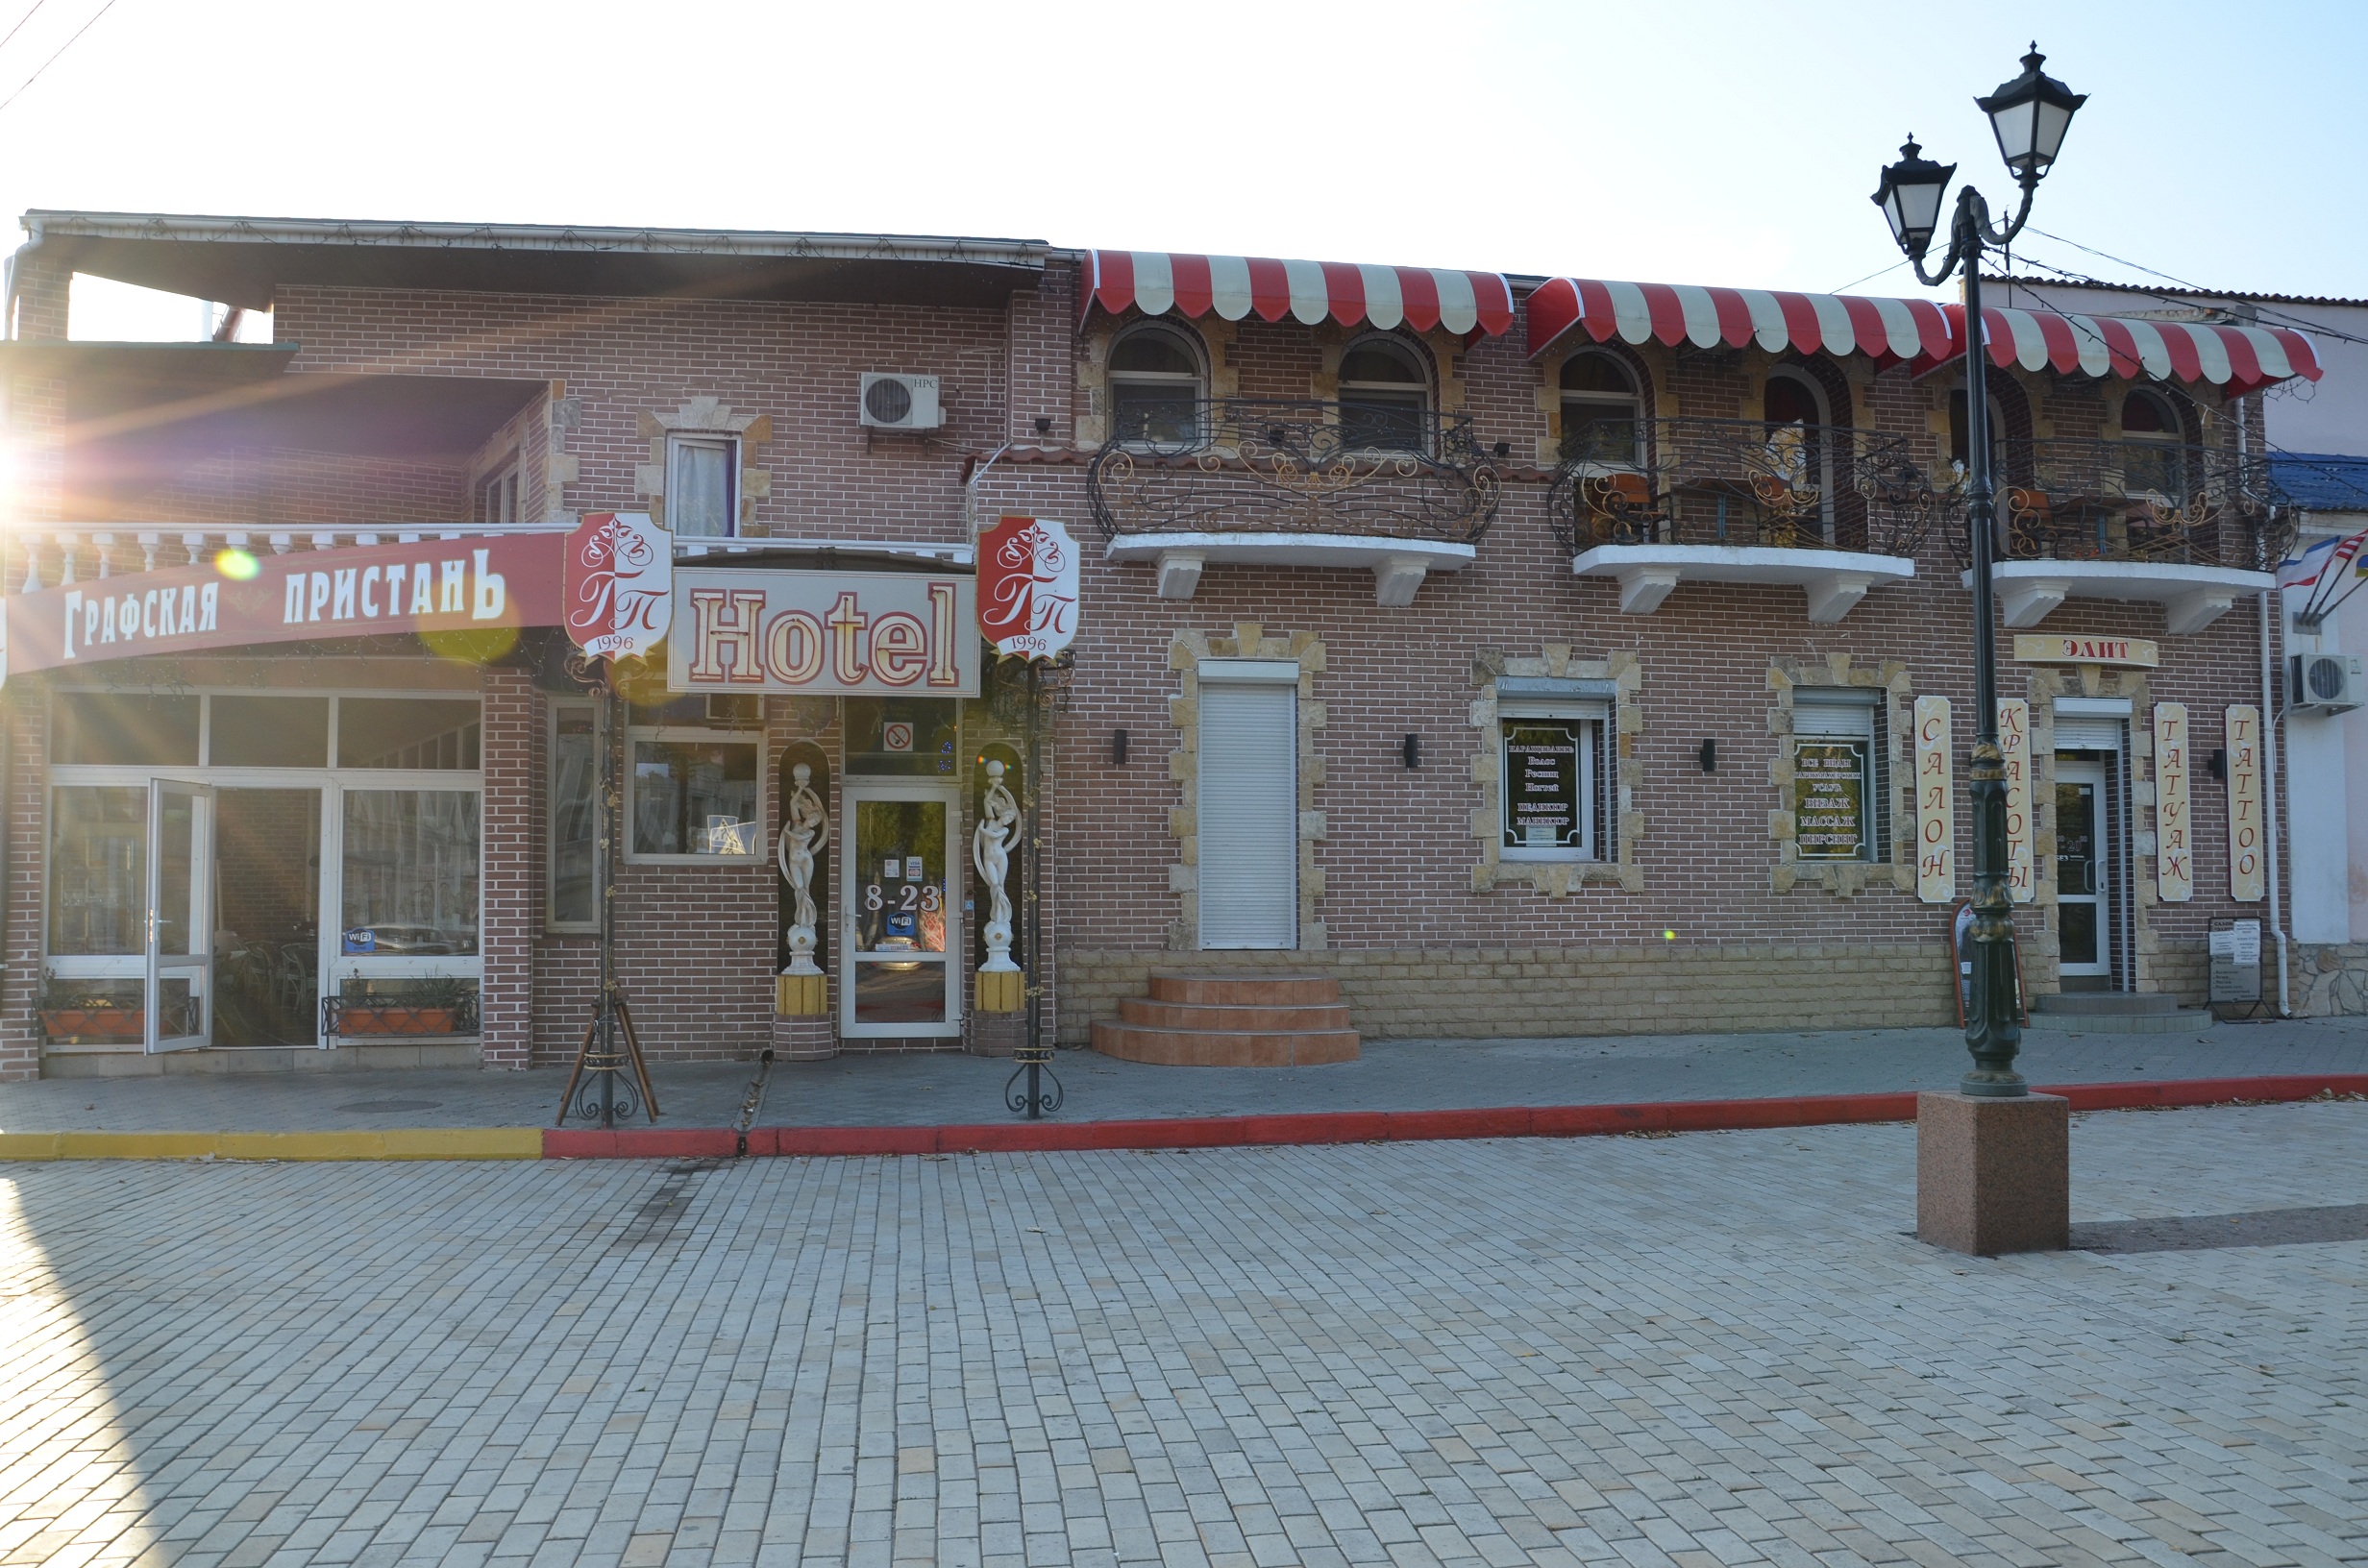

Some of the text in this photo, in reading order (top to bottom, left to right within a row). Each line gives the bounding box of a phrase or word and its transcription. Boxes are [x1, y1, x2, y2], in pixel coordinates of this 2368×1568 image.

[914, 379, 938, 389] HPC
[63, 548, 506, 660] ГРАФСКАЯ ПРИСТАНЬ
[689, 581, 960, 688] Hotel
[597, 635, 634, 651] 1996
[1011, 635, 1047, 651] 1996
[2061, 638, 2130, 659] ЭЛИТ
[1805, 797, 1850, 809] ВИЗАЖ
[1922, 718, 1950, 878] САЛОН
[1999, 707, 2029, 888] КРАСОТЫ
[2161, 719, 2189, 882] ТАТУАЖ
[1517, 816, 1569, 826] МАНИКЮР
[1800, 816, 1856, 827] МАССАЖ
[1798, 833, 1858, 845] ПИРСИНГ
